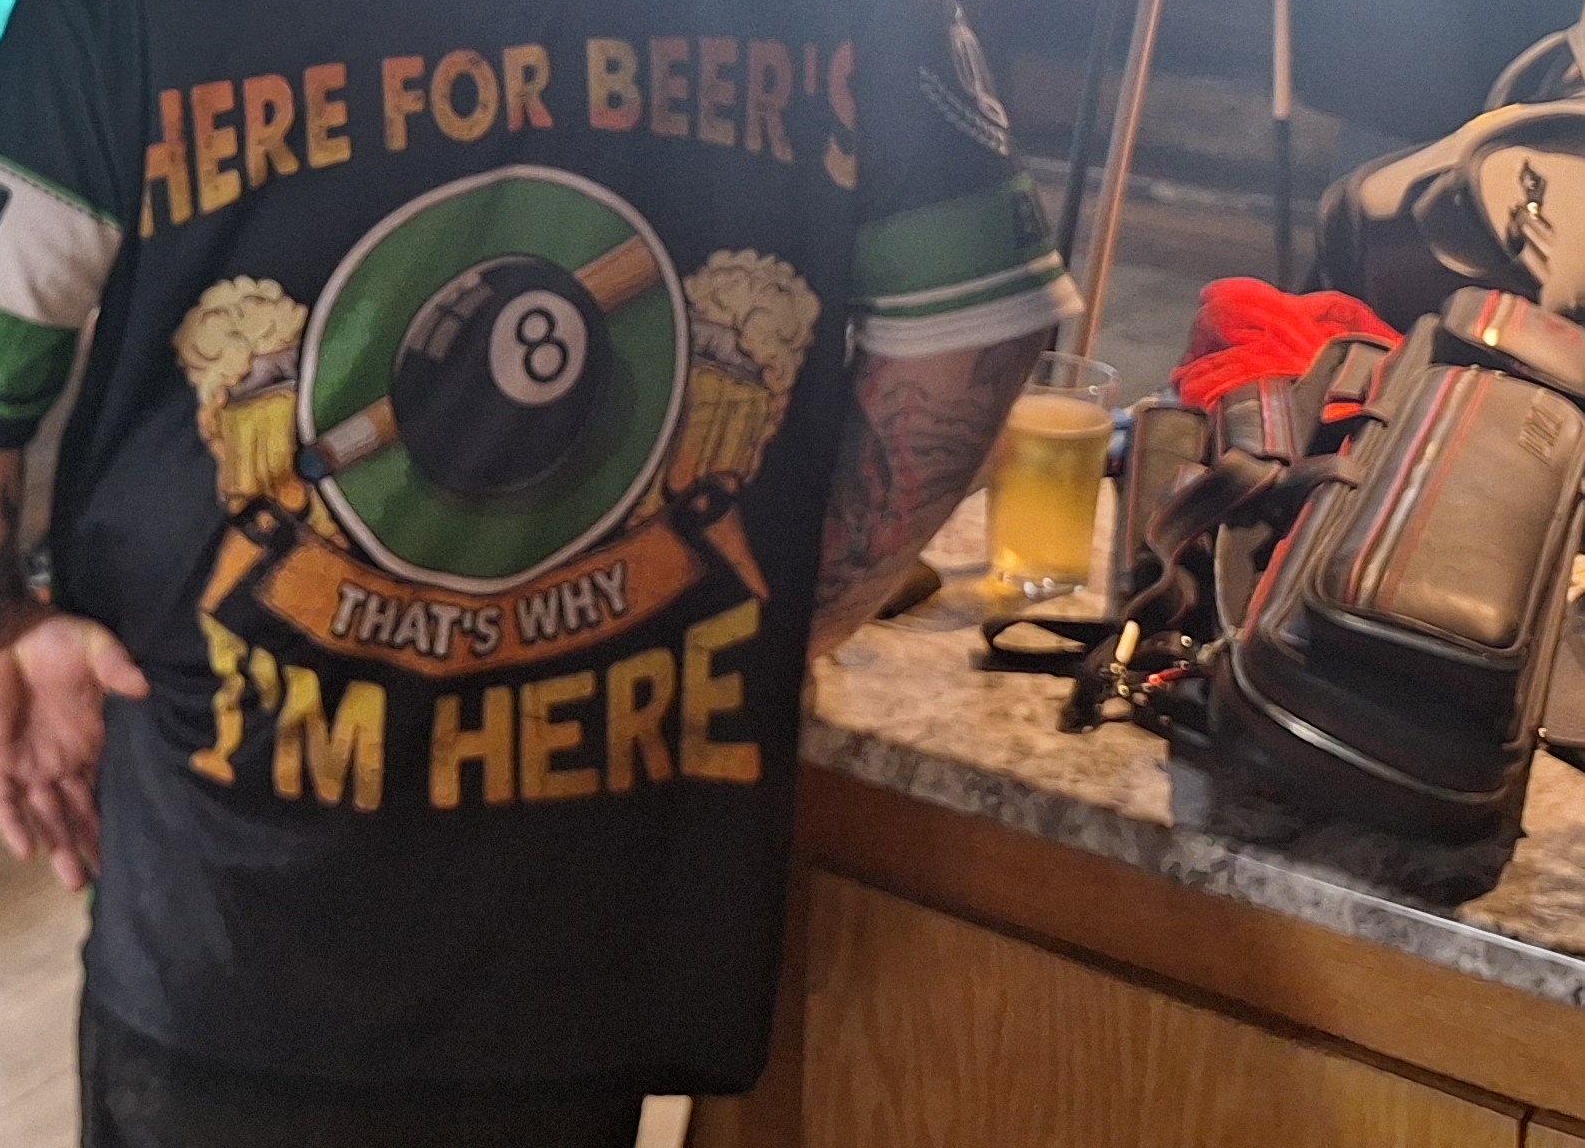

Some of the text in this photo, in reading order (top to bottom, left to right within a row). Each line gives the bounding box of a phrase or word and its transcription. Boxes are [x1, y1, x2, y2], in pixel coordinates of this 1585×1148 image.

[139, 63, 352, 240] HERE
[381, 43, 555, 151] FOR
[515, 307, 569, 384] 8
[330, 558, 629, 661] THAT'S WHY
[189, 598, 761, 812] I'M HERE
